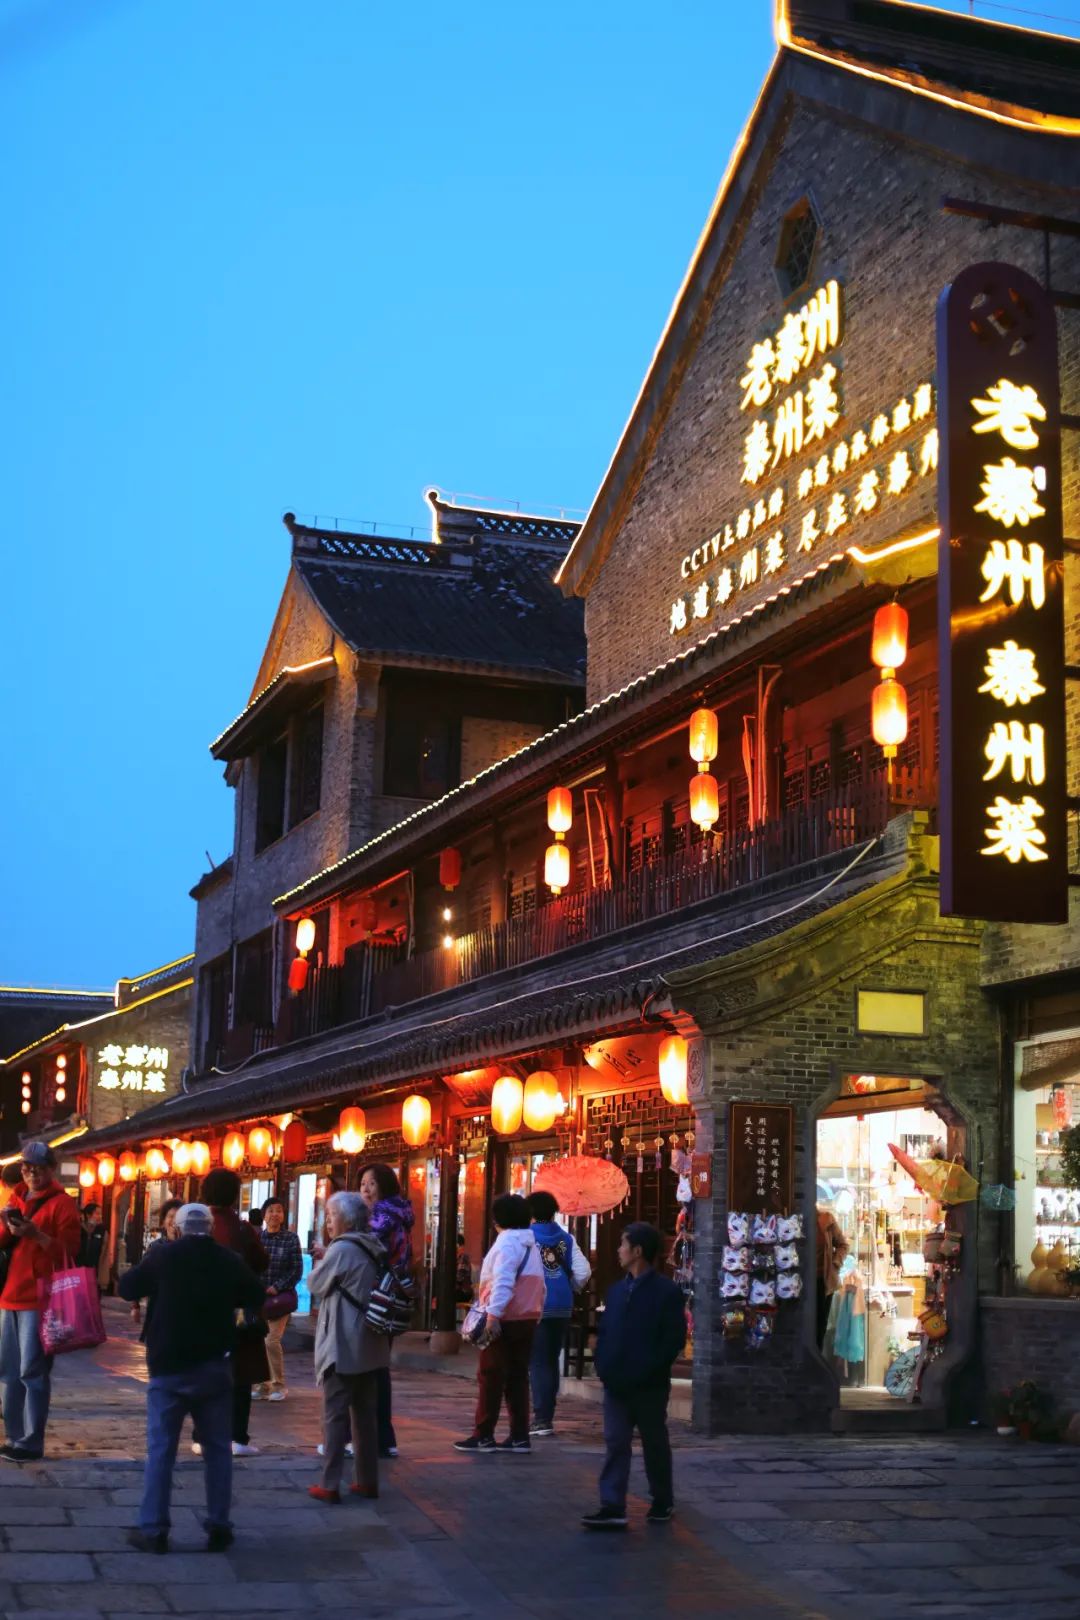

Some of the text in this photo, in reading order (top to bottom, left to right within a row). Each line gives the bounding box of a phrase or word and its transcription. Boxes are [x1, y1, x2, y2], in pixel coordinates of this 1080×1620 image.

[740, 279, 839, 411] 老泰州
[740, 362, 839, 484] 泰州菜
[974, 379, 1048, 864] 老泰州 泰州菜
[97, 1043, 169, 1070] 老泰州
[97, 1067, 167, 1093] 泰州菜
